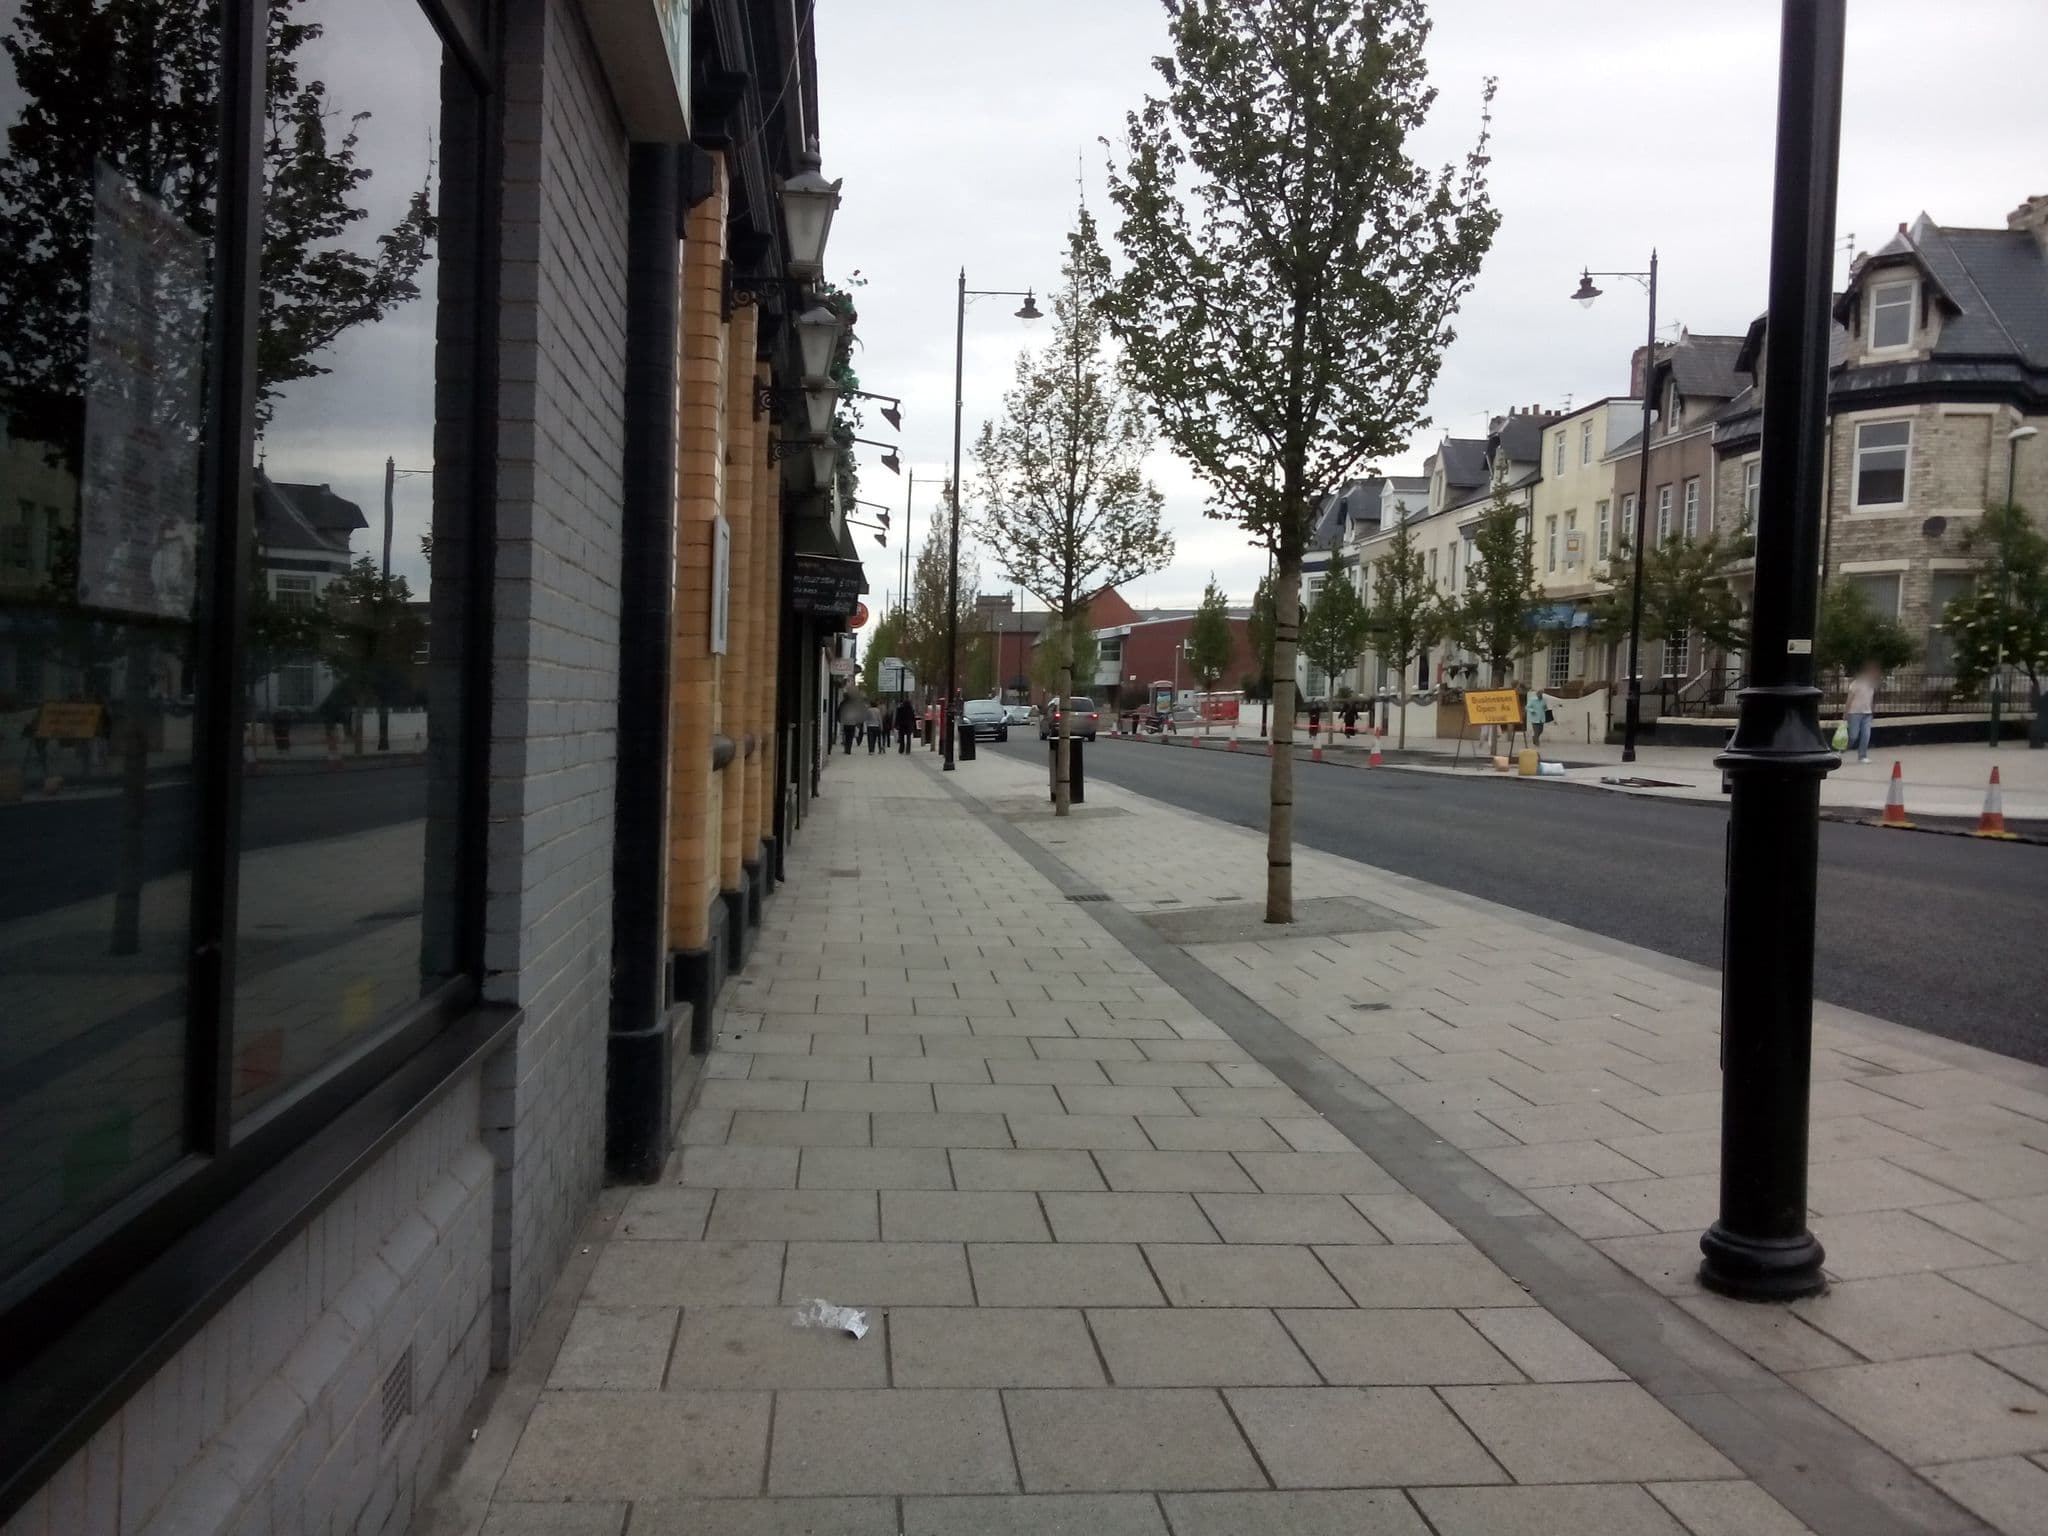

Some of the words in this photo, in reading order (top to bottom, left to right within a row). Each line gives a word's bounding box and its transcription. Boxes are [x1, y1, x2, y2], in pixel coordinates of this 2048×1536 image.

[1471, 696, 1513, 704] Businesses
[1476, 704, 1496, 714] Open
[1501, 704, 1511, 712] As
